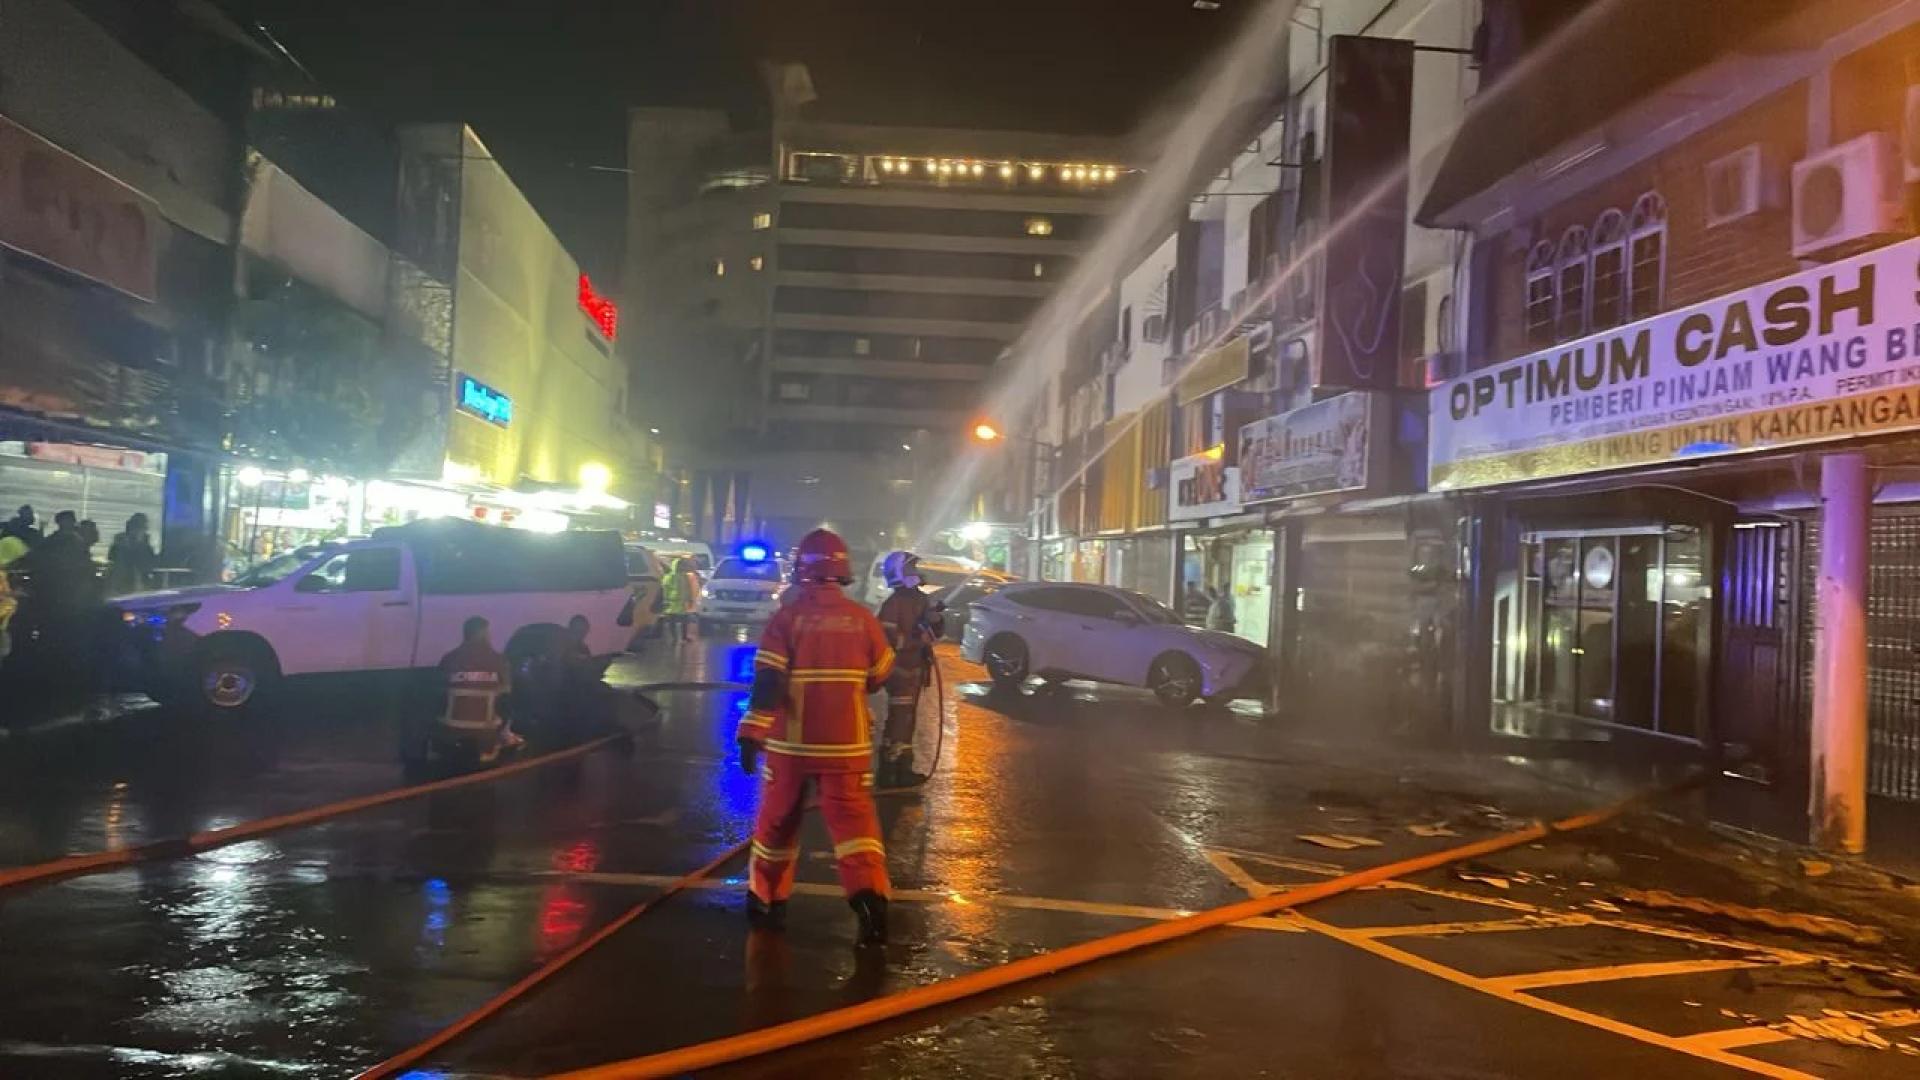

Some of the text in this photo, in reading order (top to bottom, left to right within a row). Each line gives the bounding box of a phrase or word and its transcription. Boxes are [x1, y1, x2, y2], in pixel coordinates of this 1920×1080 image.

[1451, 329, 1651, 421] OPTIMUM
[1675, 263, 1876, 366] CASH
[1551, 387, 1642, 425] PEMBERI
[1652, 360, 1753, 408] PINJAM
[1767, 335, 1867, 385] WANG
[1835, 369, 1896, 394] PERMIT
[1669, 418, 1742, 452] UNTUK
